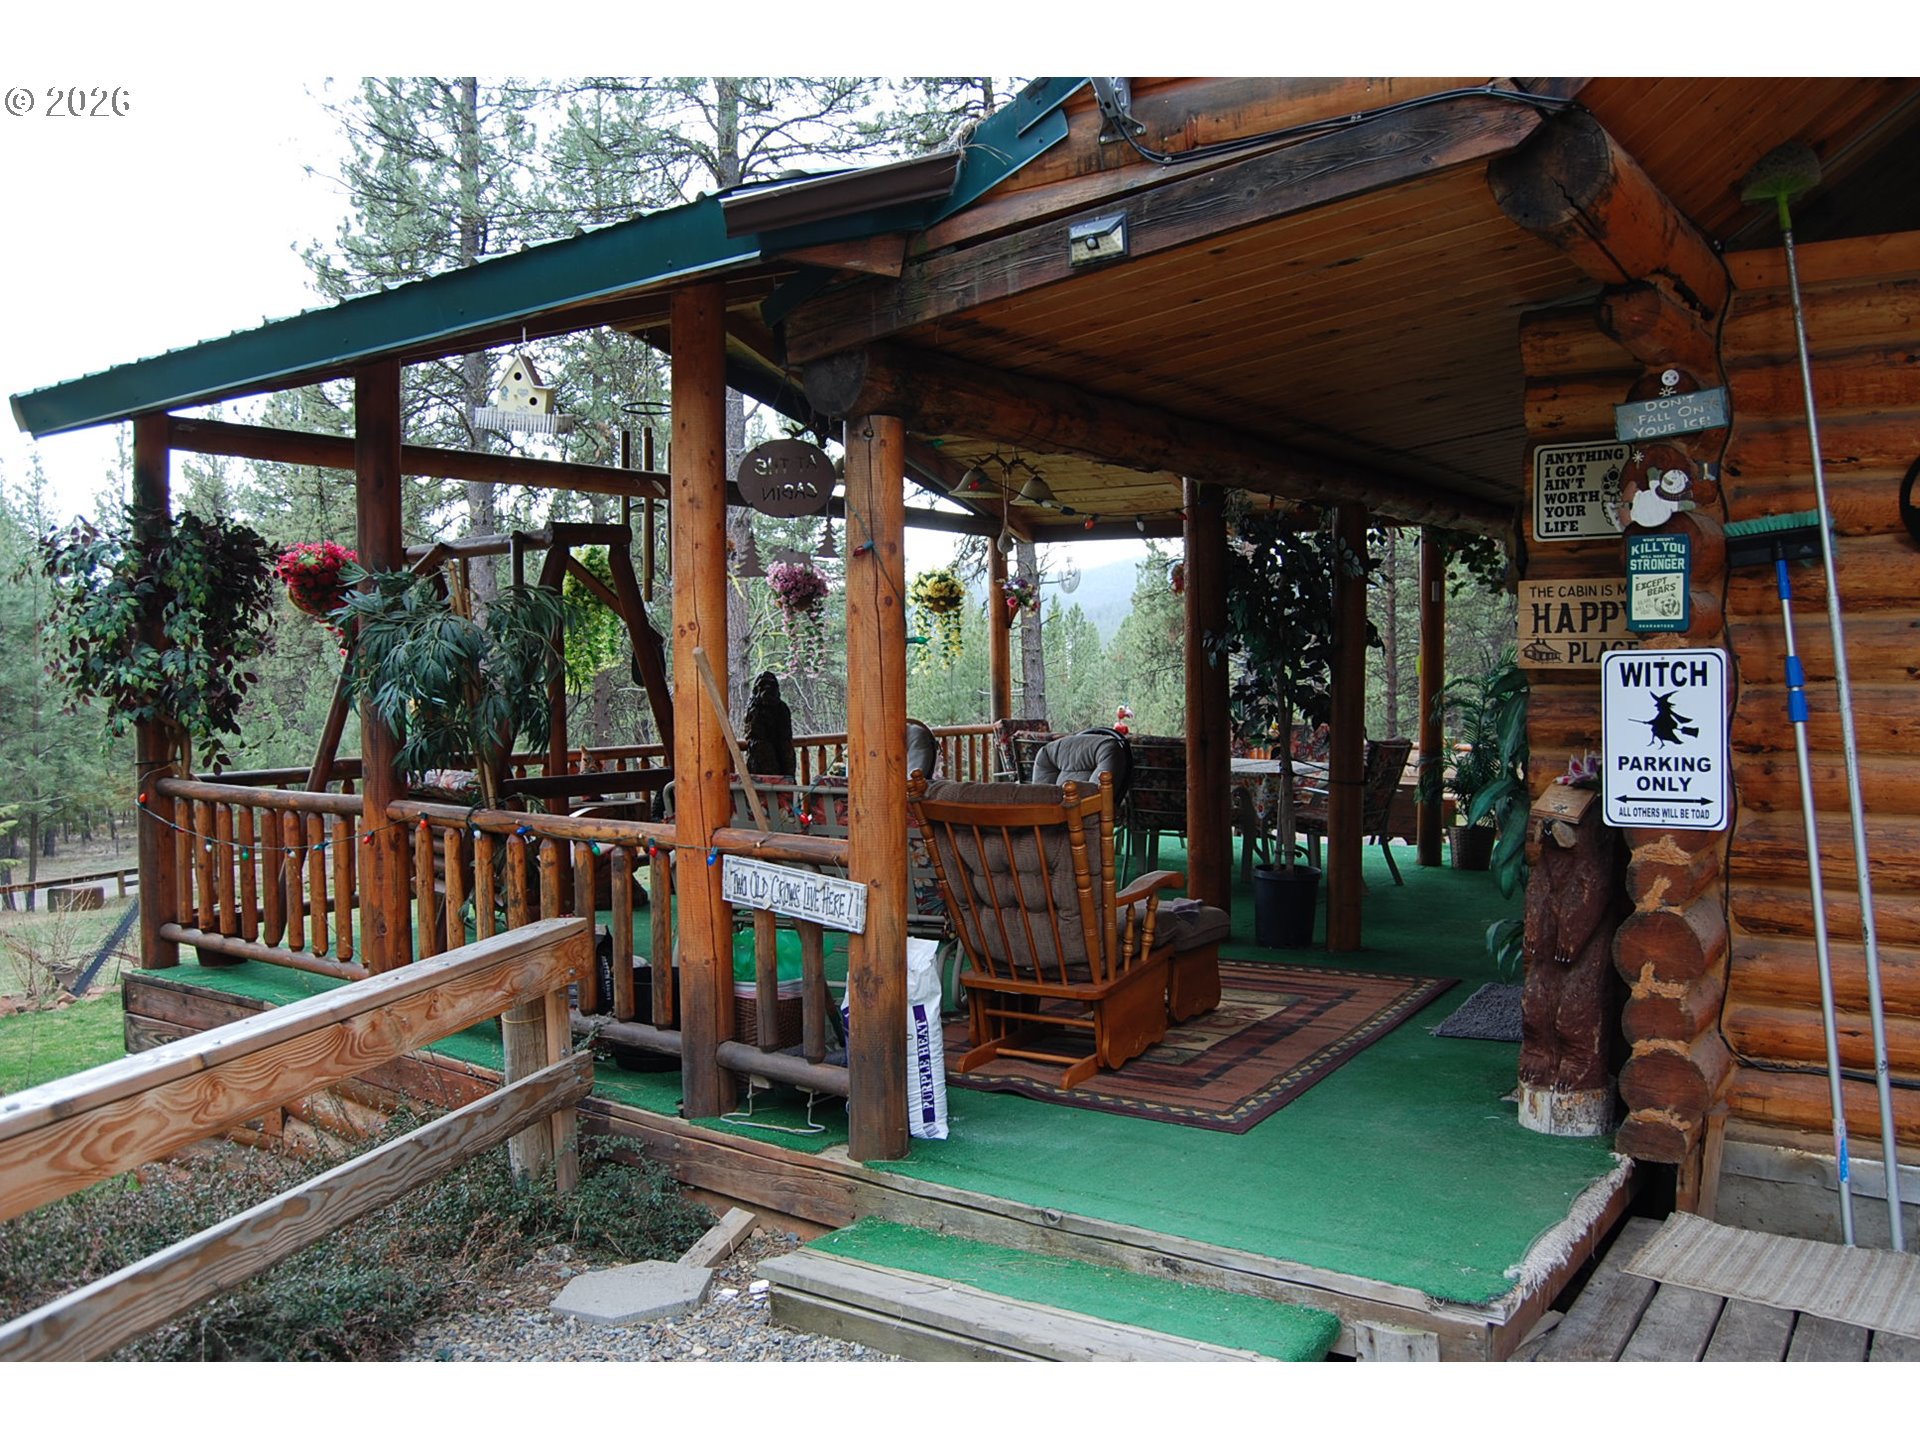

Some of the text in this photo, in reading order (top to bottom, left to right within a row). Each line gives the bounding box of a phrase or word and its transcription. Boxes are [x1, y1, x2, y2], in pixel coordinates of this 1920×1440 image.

[1645, 394, 1695, 412] DON'T
[1638, 406, 1704, 425] FALL ON
[1633, 416, 1711, 438] YOUR ICE!
[1544, 448, 1624, 465] ANYTHING
[1544, 464, 1587, 478] I GOT
[1544, 477, 1585, 491] AIN'T
[1544, 490, 1600, 505] WORTH
[1544, 505, 1586, 518] YOUR
[1544, 520, 1579, 533] LIFE
[1631, 542, 1686, 556] KILL YOU
[1630, 558, 1686, 571] STRONGER
[1529, 584, 1627, 598] THE CABIN IS M
[1635, 576, 1668, 591] EXCEPT
[1647, 582, 1676, 597] BEARS
[1619, 660, 1708, 687] WITCH
[1617, 756, 1711, 772] PARKING
[1636, 776, 1692, 792] ONLY
[1619, 806, 1710, 820] ALL OTHERS WILL BE TOAD
[750, 870, 768, 899] OLD
[770, 875, 801, 908] CROWS
[803, 882, 820, 913] LIVE
[916, 1019, 934, 1110] PURPLE HEAT
